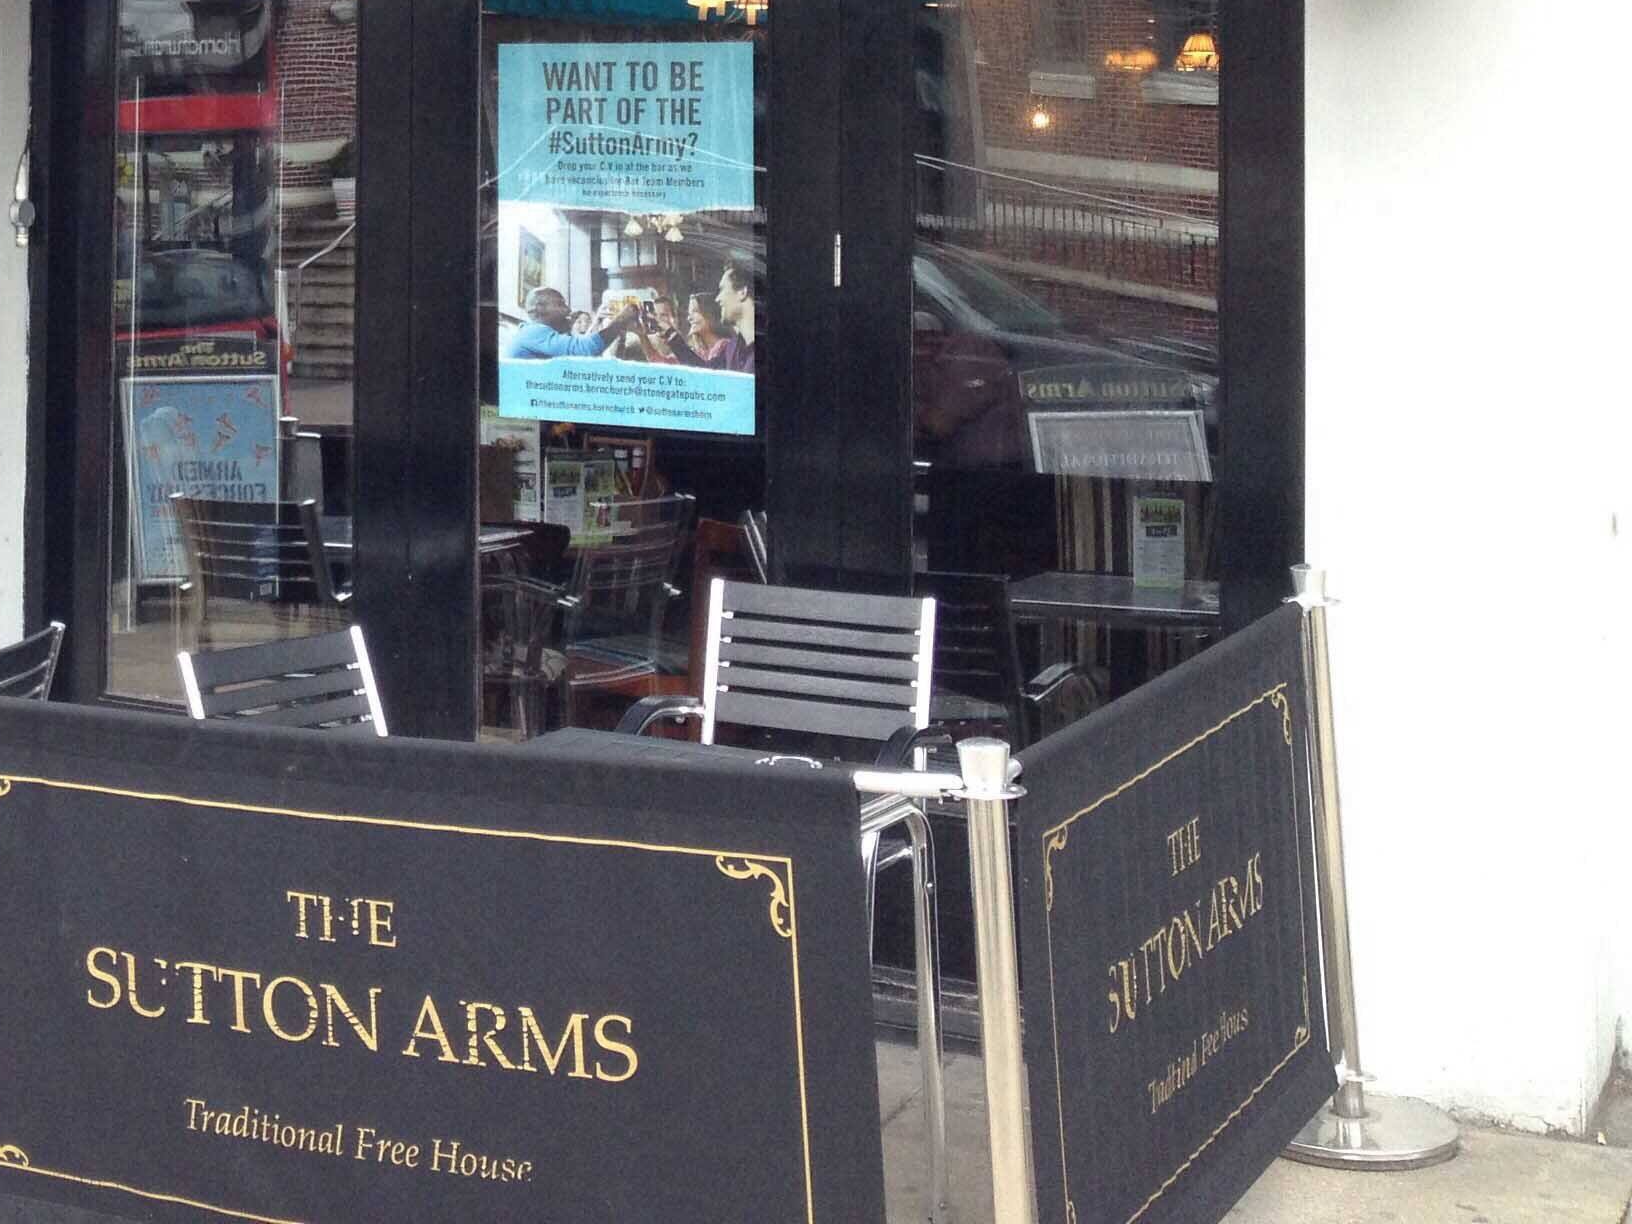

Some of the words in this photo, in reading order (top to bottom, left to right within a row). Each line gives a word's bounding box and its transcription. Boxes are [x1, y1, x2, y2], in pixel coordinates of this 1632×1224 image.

[542, 61, 617, 92] WANT
[626, 61, 658, 92] TO
[670, 61, 705, 92] BE
[546, 97, 607, 125] PART
[617, 98, 647, 125] OF
[656, 98, 702, 126] THE
[549, 131, 698, 161] #SuttonArmy?
[616, 374, 635, 385] send
[638, 376, 656, 387] your
[1168, 816, 1202, 877] THE
[287, 889, 397, 948] THE
[1108, 899, 1203, 1034] SUTTON
[86, 946, 382, 1053] SUTTON
[402, 995, 639, 1083] ARMS
[184, 1098, 343, 1157] Traditional
[354, 1127, 420, 1168] Free
[431, 1138, 533, 1183] House
